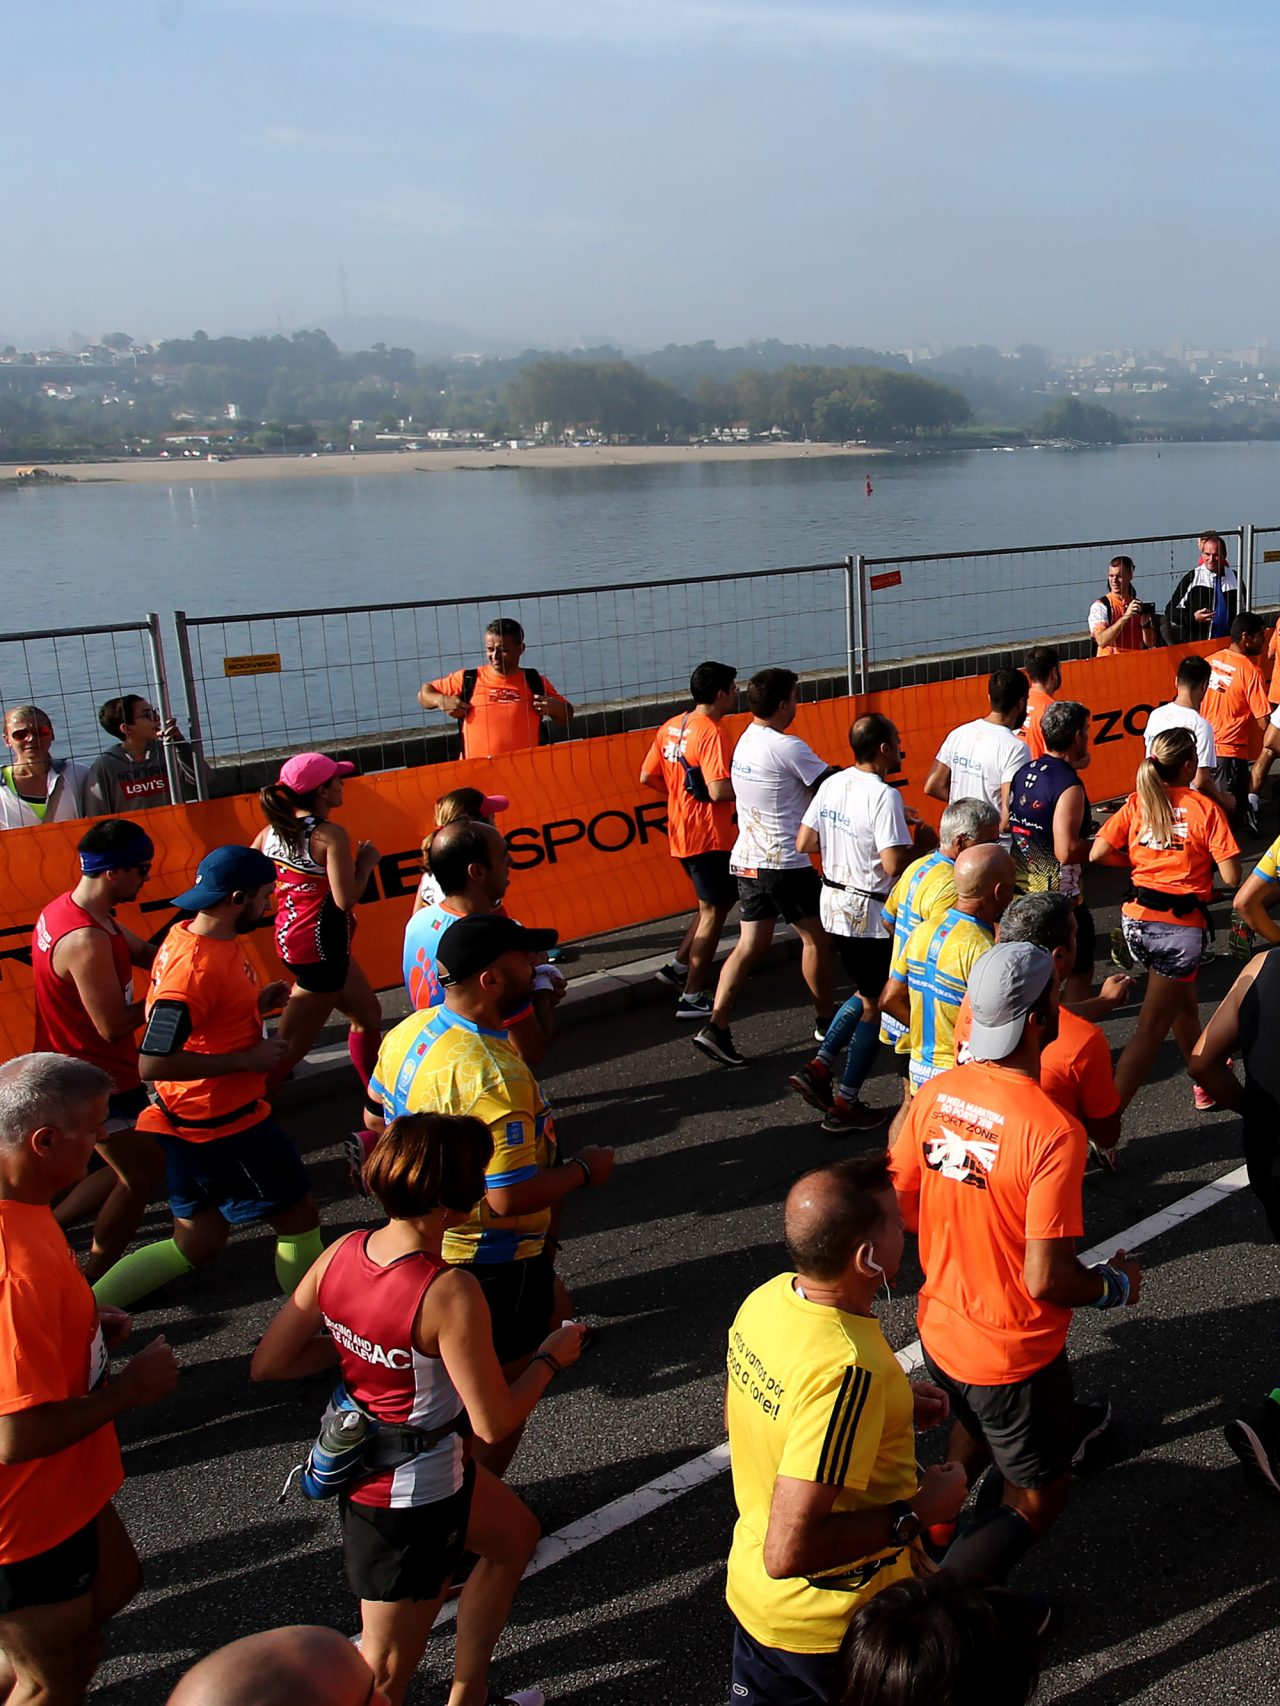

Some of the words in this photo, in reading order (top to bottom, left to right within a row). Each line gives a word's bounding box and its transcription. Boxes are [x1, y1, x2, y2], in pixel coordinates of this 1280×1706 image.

[504, 802, 669, 871] SPOR
[946, 1096, 966, 1109] MEIA
[965, 1102, 1005, 1126] MARATONA
[951, 1106, 978, 1123] PORTO
[932, 1111, 966, 1127] SPORT
[966, 1123, 999, 1143] ZONE
[353, 1333, 372, 1352] AND
[372, 1344, 412, 1370] AC
[741, 1371, 750, 1385] a
